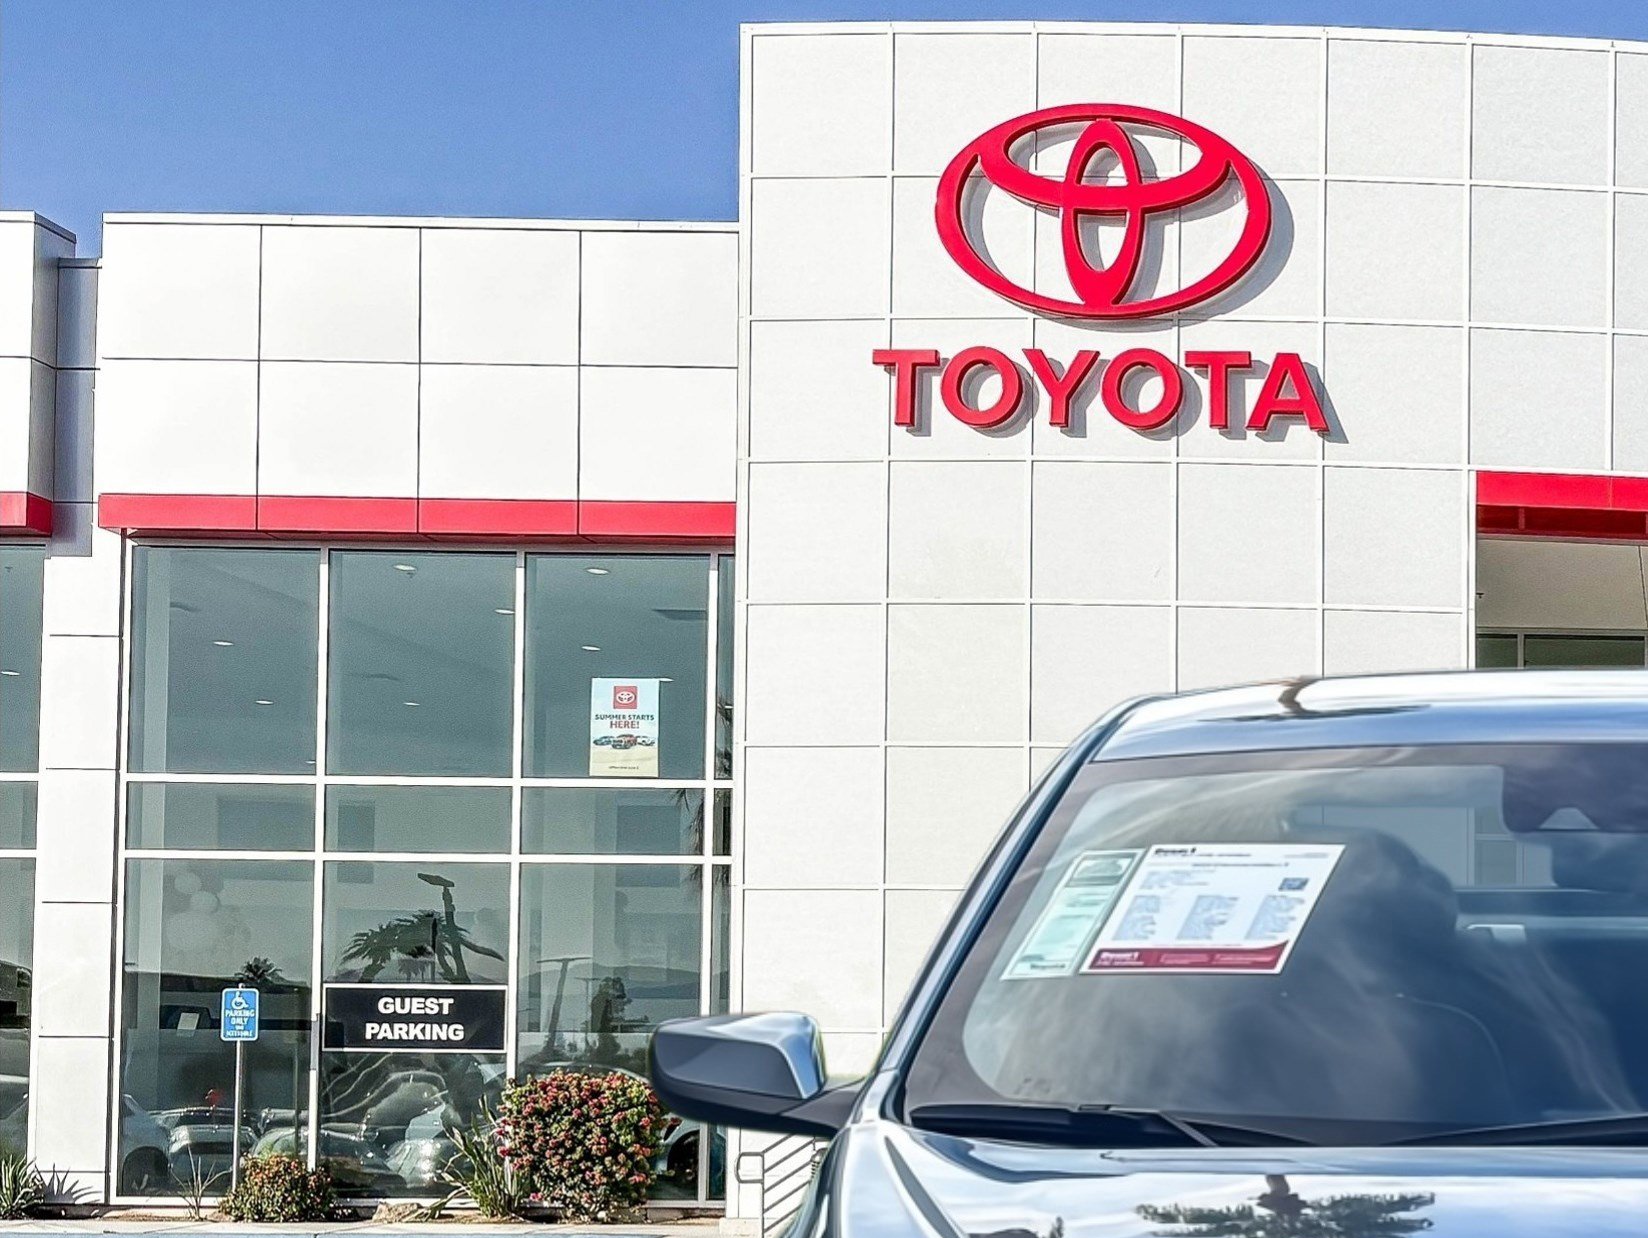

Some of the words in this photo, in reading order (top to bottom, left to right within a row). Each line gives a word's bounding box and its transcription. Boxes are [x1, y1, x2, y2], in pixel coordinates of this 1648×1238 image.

[873, 345, 1330, 432] TOYOTA
[594, 713, 627, 721] SUMMER
[609, 720, 640, 729] HERE!
[225, 1009, 255, 1017] PARKING
[377, 996, 455, 1016] GUEST
[365, 1022, 465, 1042] PARKING
